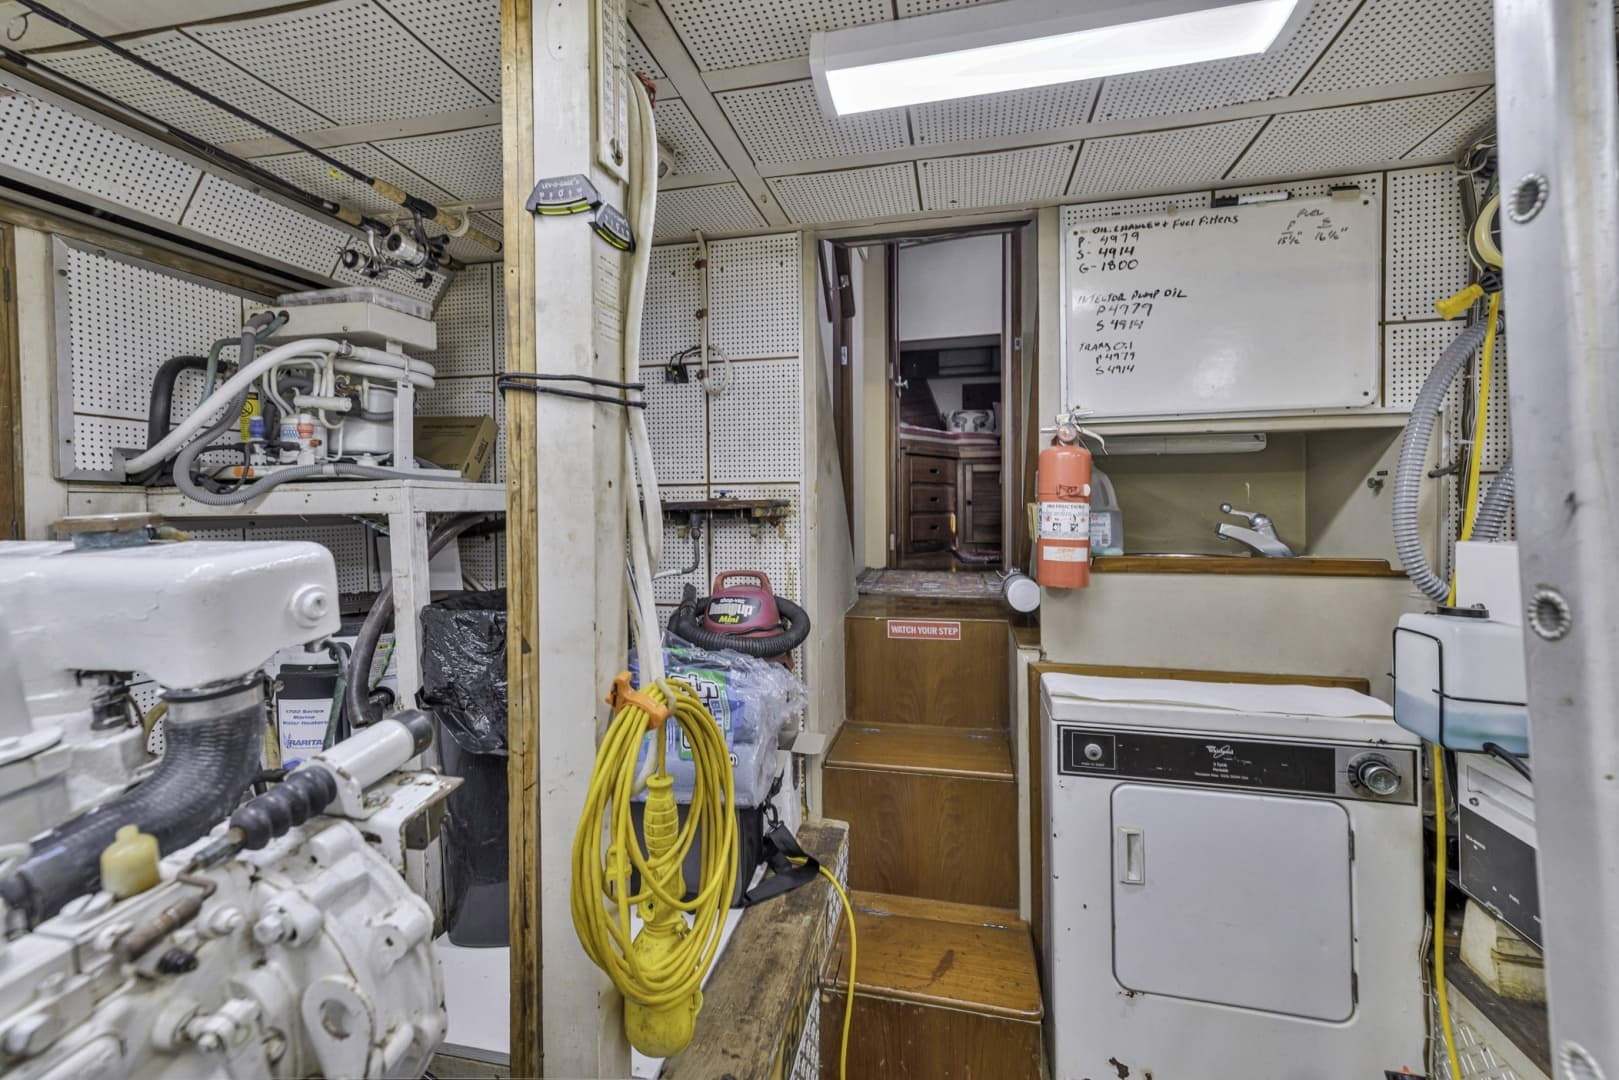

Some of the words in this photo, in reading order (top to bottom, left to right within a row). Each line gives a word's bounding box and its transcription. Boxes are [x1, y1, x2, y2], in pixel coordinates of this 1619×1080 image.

[1172, 218, 1195, 229] Fuel
[1098, 246, 1135, 259] 4914
[718, 615, 740, 624] Mini
[890, 624, 917, 635] WATCH
[916, 625, 938, 636] YOUR
[938, 626, 959, 637] STEP
